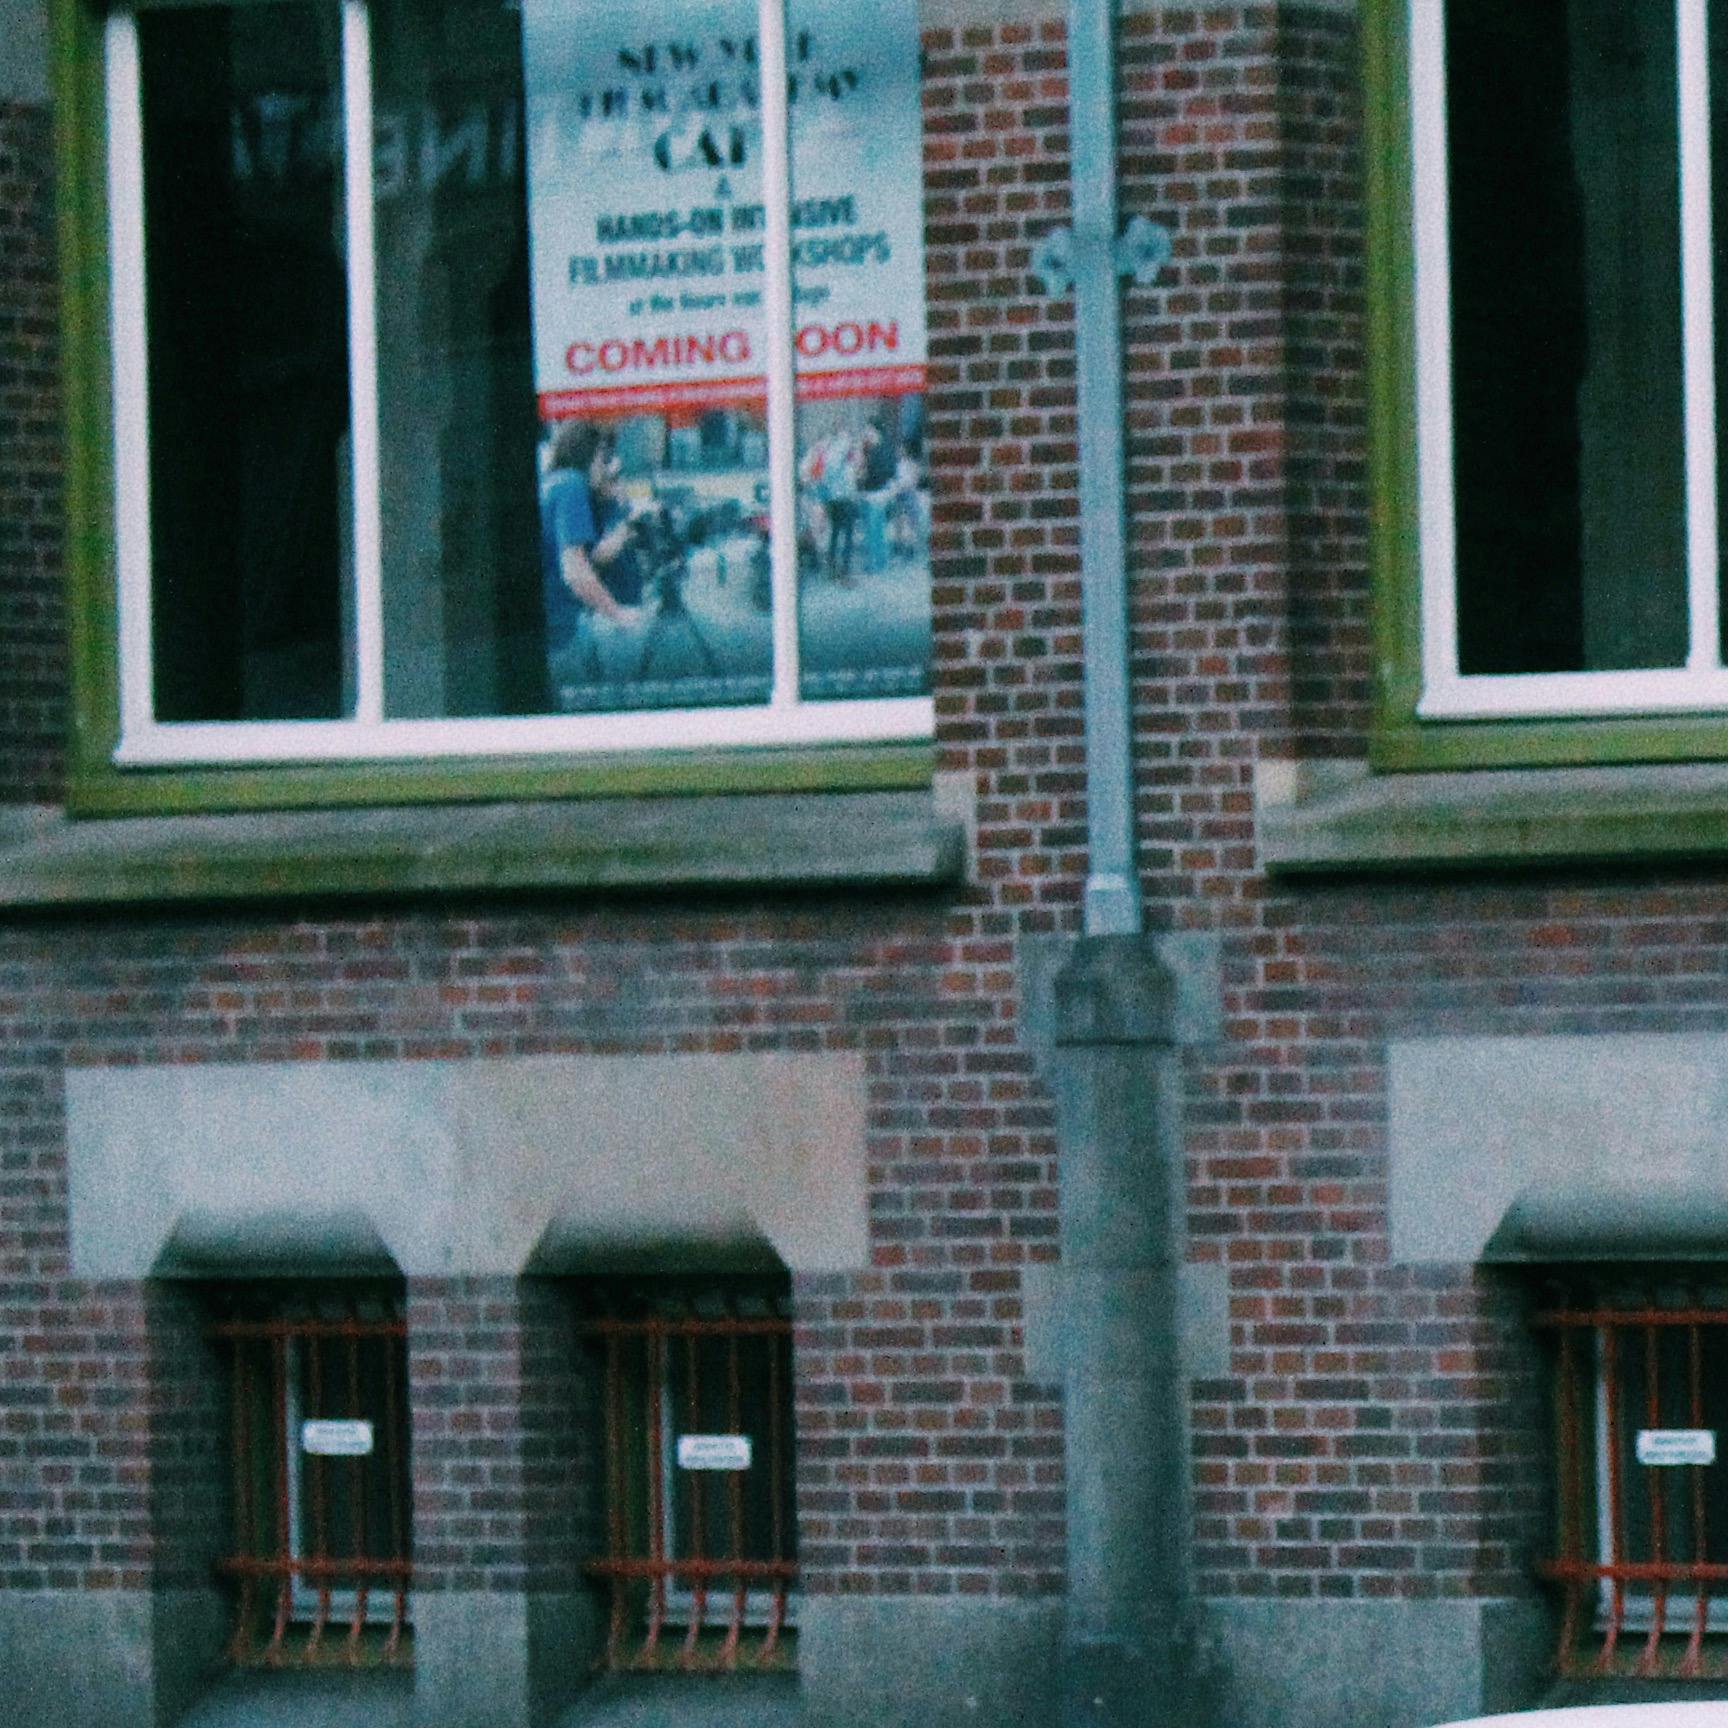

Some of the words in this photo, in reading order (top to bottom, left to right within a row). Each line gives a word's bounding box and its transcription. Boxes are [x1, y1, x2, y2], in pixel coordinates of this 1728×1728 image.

[653, 125, 764, 173] CAF
[596, 208, 724, 244] HANDS-ON
[731, 196, 856, 231] INTNSIVE
[567, 248, 725, 290] FILMMAKING
[732, 231, 891, 272] WKSHOPS
[566, 331, 748, 375] COMING
[796, 319, 899, 358] OON
